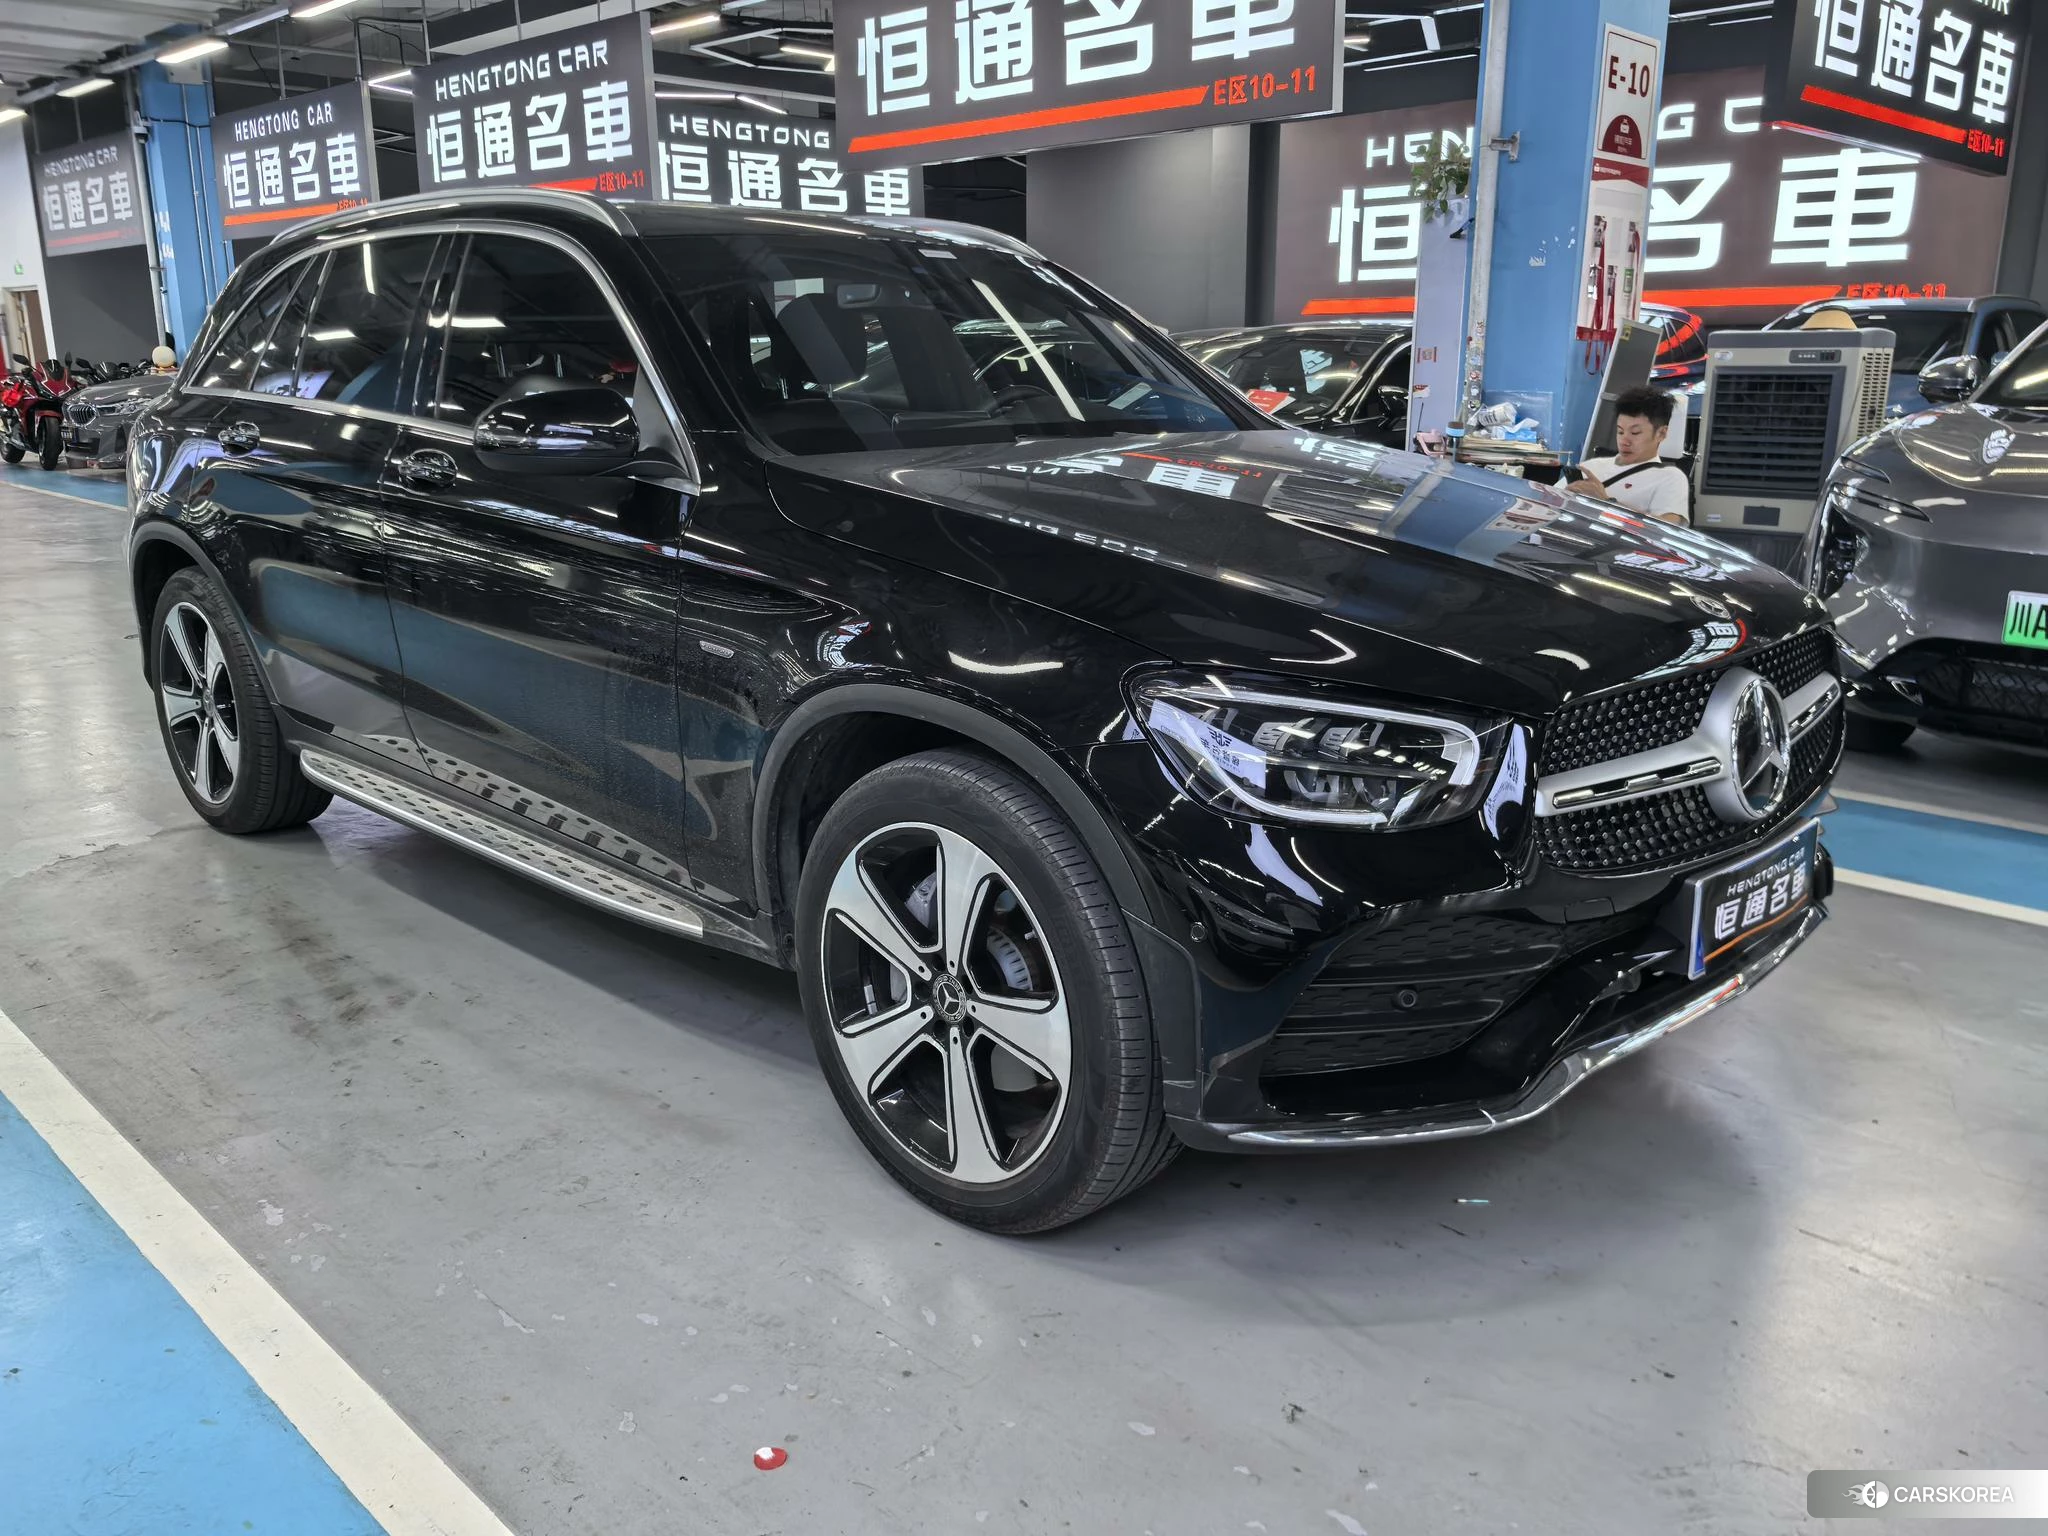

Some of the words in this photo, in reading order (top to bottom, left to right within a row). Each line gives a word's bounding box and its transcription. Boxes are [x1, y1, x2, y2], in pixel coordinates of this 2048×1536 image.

[435, 53, 551, 101] HENGTONG
[558, 39, 609, 73] CAR
[1213, 65, 1316, 106] E区10-11
[1608, 55, 1651, 98] E-10
[1813, 0, 2016, 123] 恒通名車
[234, 109, 300, 142] HENGTONG
[307, 102, 333, 126] CAR
[426, 80, 633, 183] 恒通名車
[669, 114, 830, 149] HENGTONG
[96, 146, 119, 165] CAR
[223, 132, 361, 209] 恒通名車
[658, 141, 911, 217] 恒通名車
[43, 171, 133, 231] 恒通名車
[1714, 861, 1806, 941] 恒通名車
[1727, 859, 1788, 897] HENGTONG
